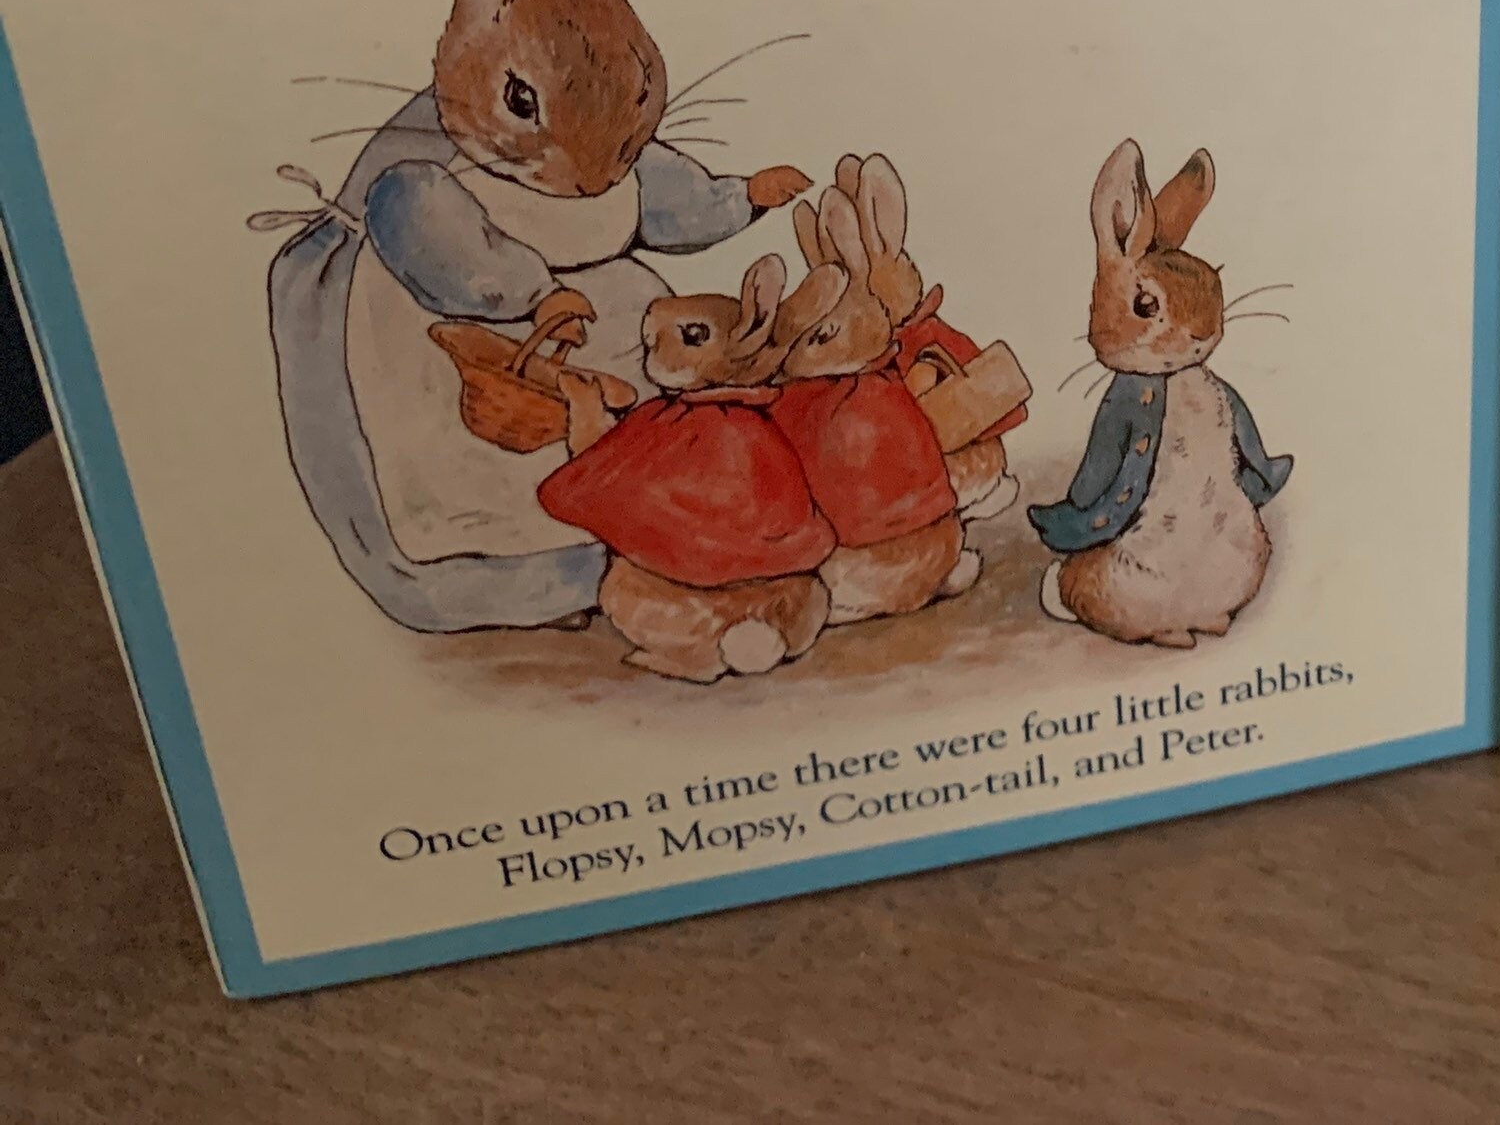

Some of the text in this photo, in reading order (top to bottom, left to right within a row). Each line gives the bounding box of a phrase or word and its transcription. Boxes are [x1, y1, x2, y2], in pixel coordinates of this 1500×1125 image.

[379, 661, 1354, 861] Once upon a time there were four little rabbits,
[497, 723, 1264, 888] Flopsy, Mopsy, Cotton-tail, and Peter.
